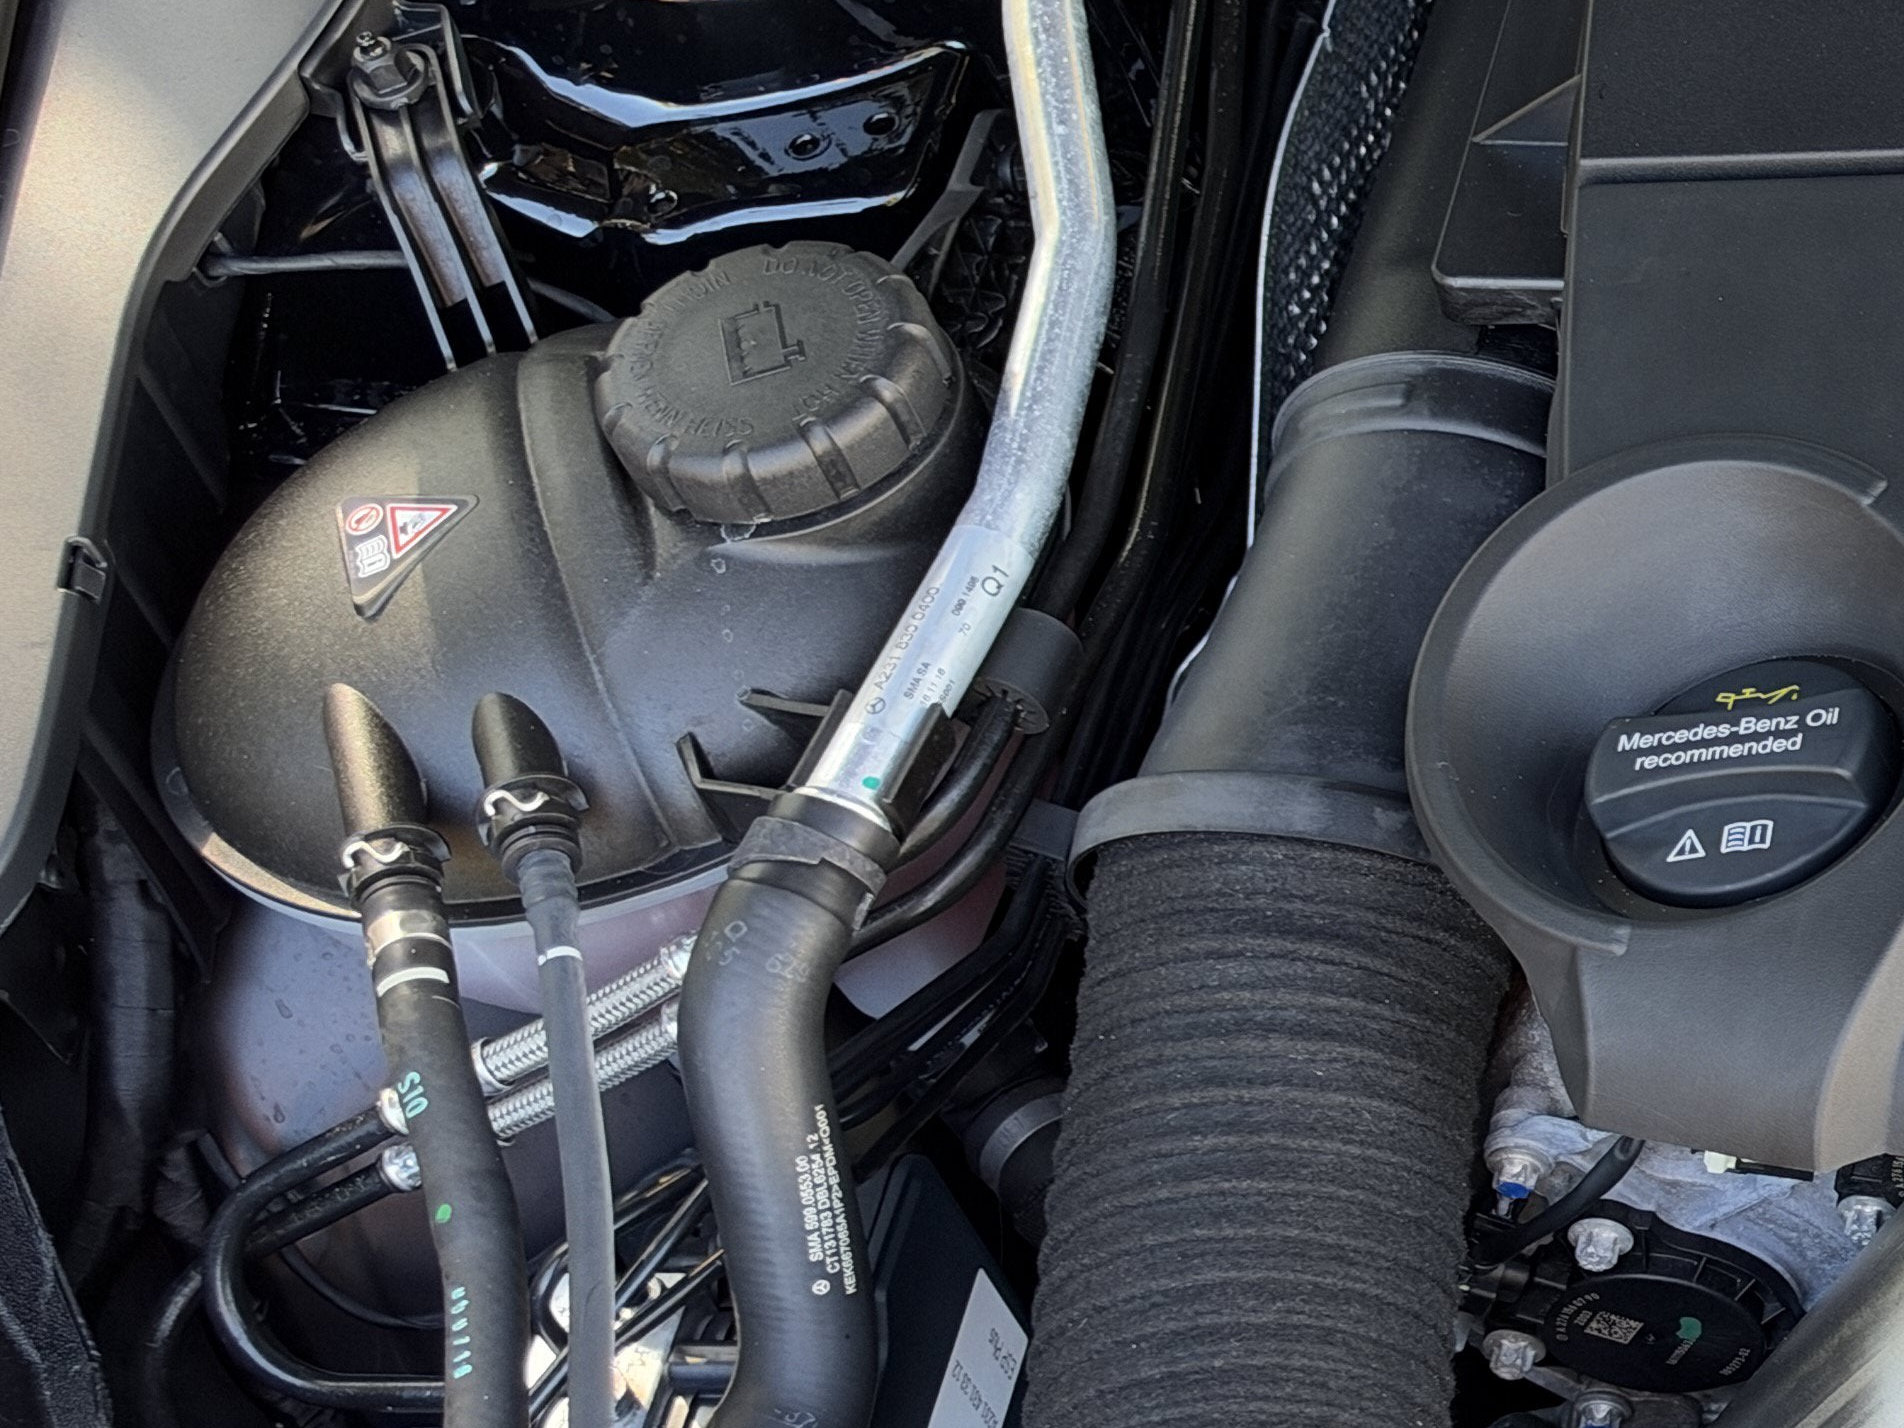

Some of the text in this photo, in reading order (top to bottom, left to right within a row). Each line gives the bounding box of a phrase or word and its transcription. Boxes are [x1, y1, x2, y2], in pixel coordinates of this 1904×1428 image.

[977, 562, 1011, 600] Q1
[1618, 707, 1839, 752] Mercedes-Benz Oil
[1635, 733, 1803, 771] recommended
